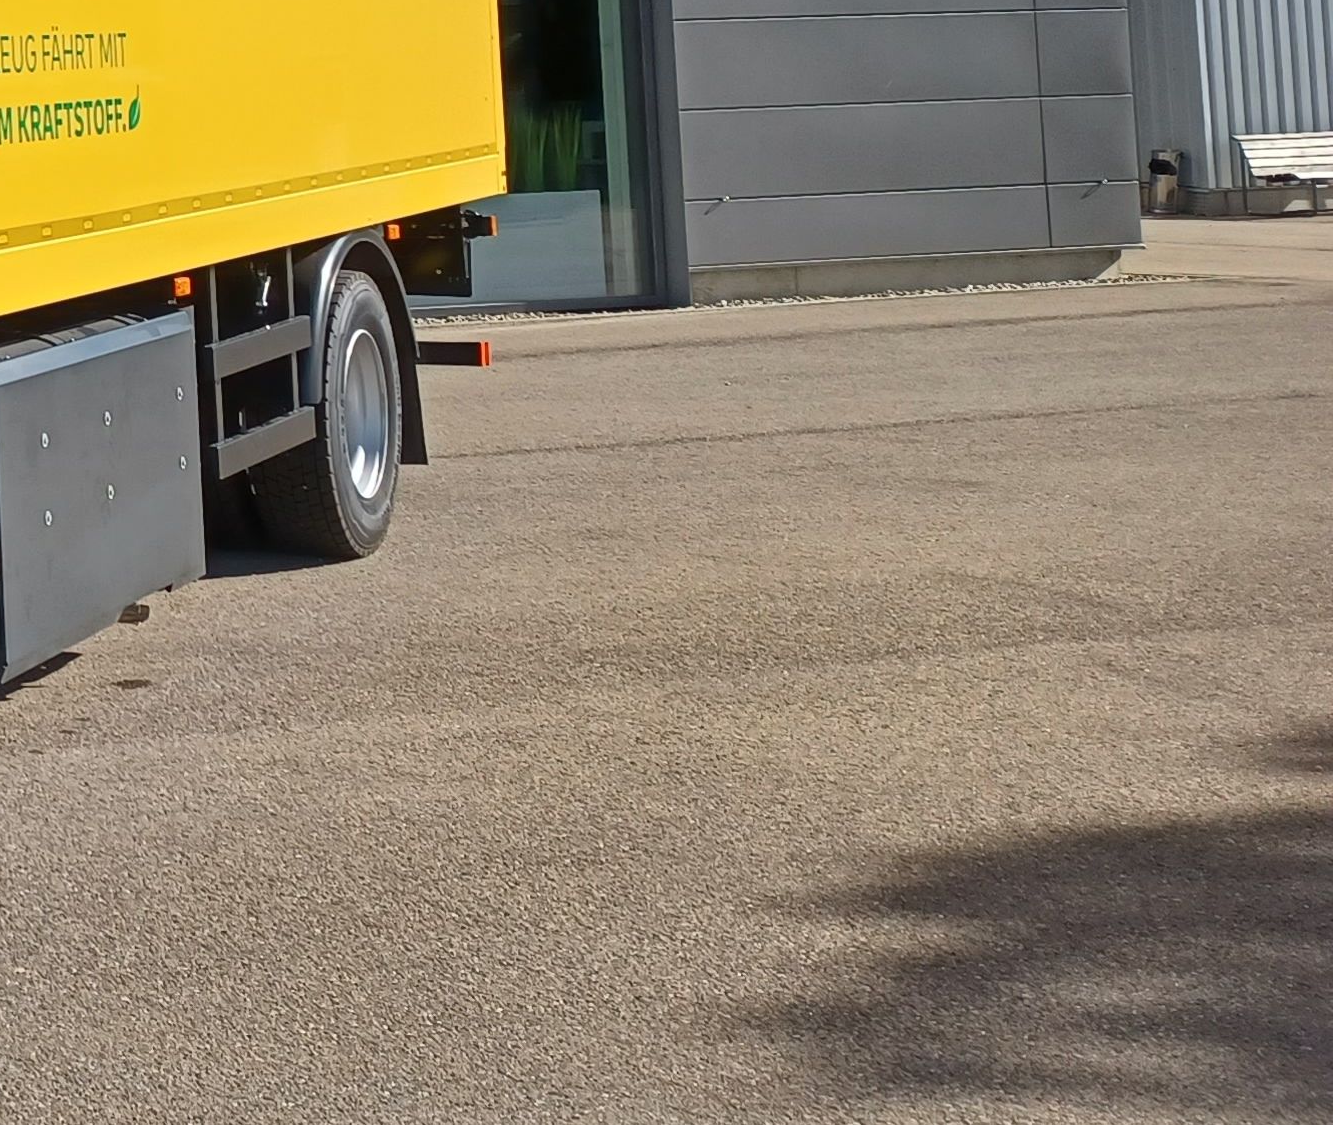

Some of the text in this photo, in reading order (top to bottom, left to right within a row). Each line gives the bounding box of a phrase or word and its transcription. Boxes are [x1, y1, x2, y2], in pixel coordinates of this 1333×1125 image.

[42, 26, 94, 71] FÄHRT
[99, 32, 127, 68] MIT
[17, 97, 127, 143] KRAFTSTOFF.
